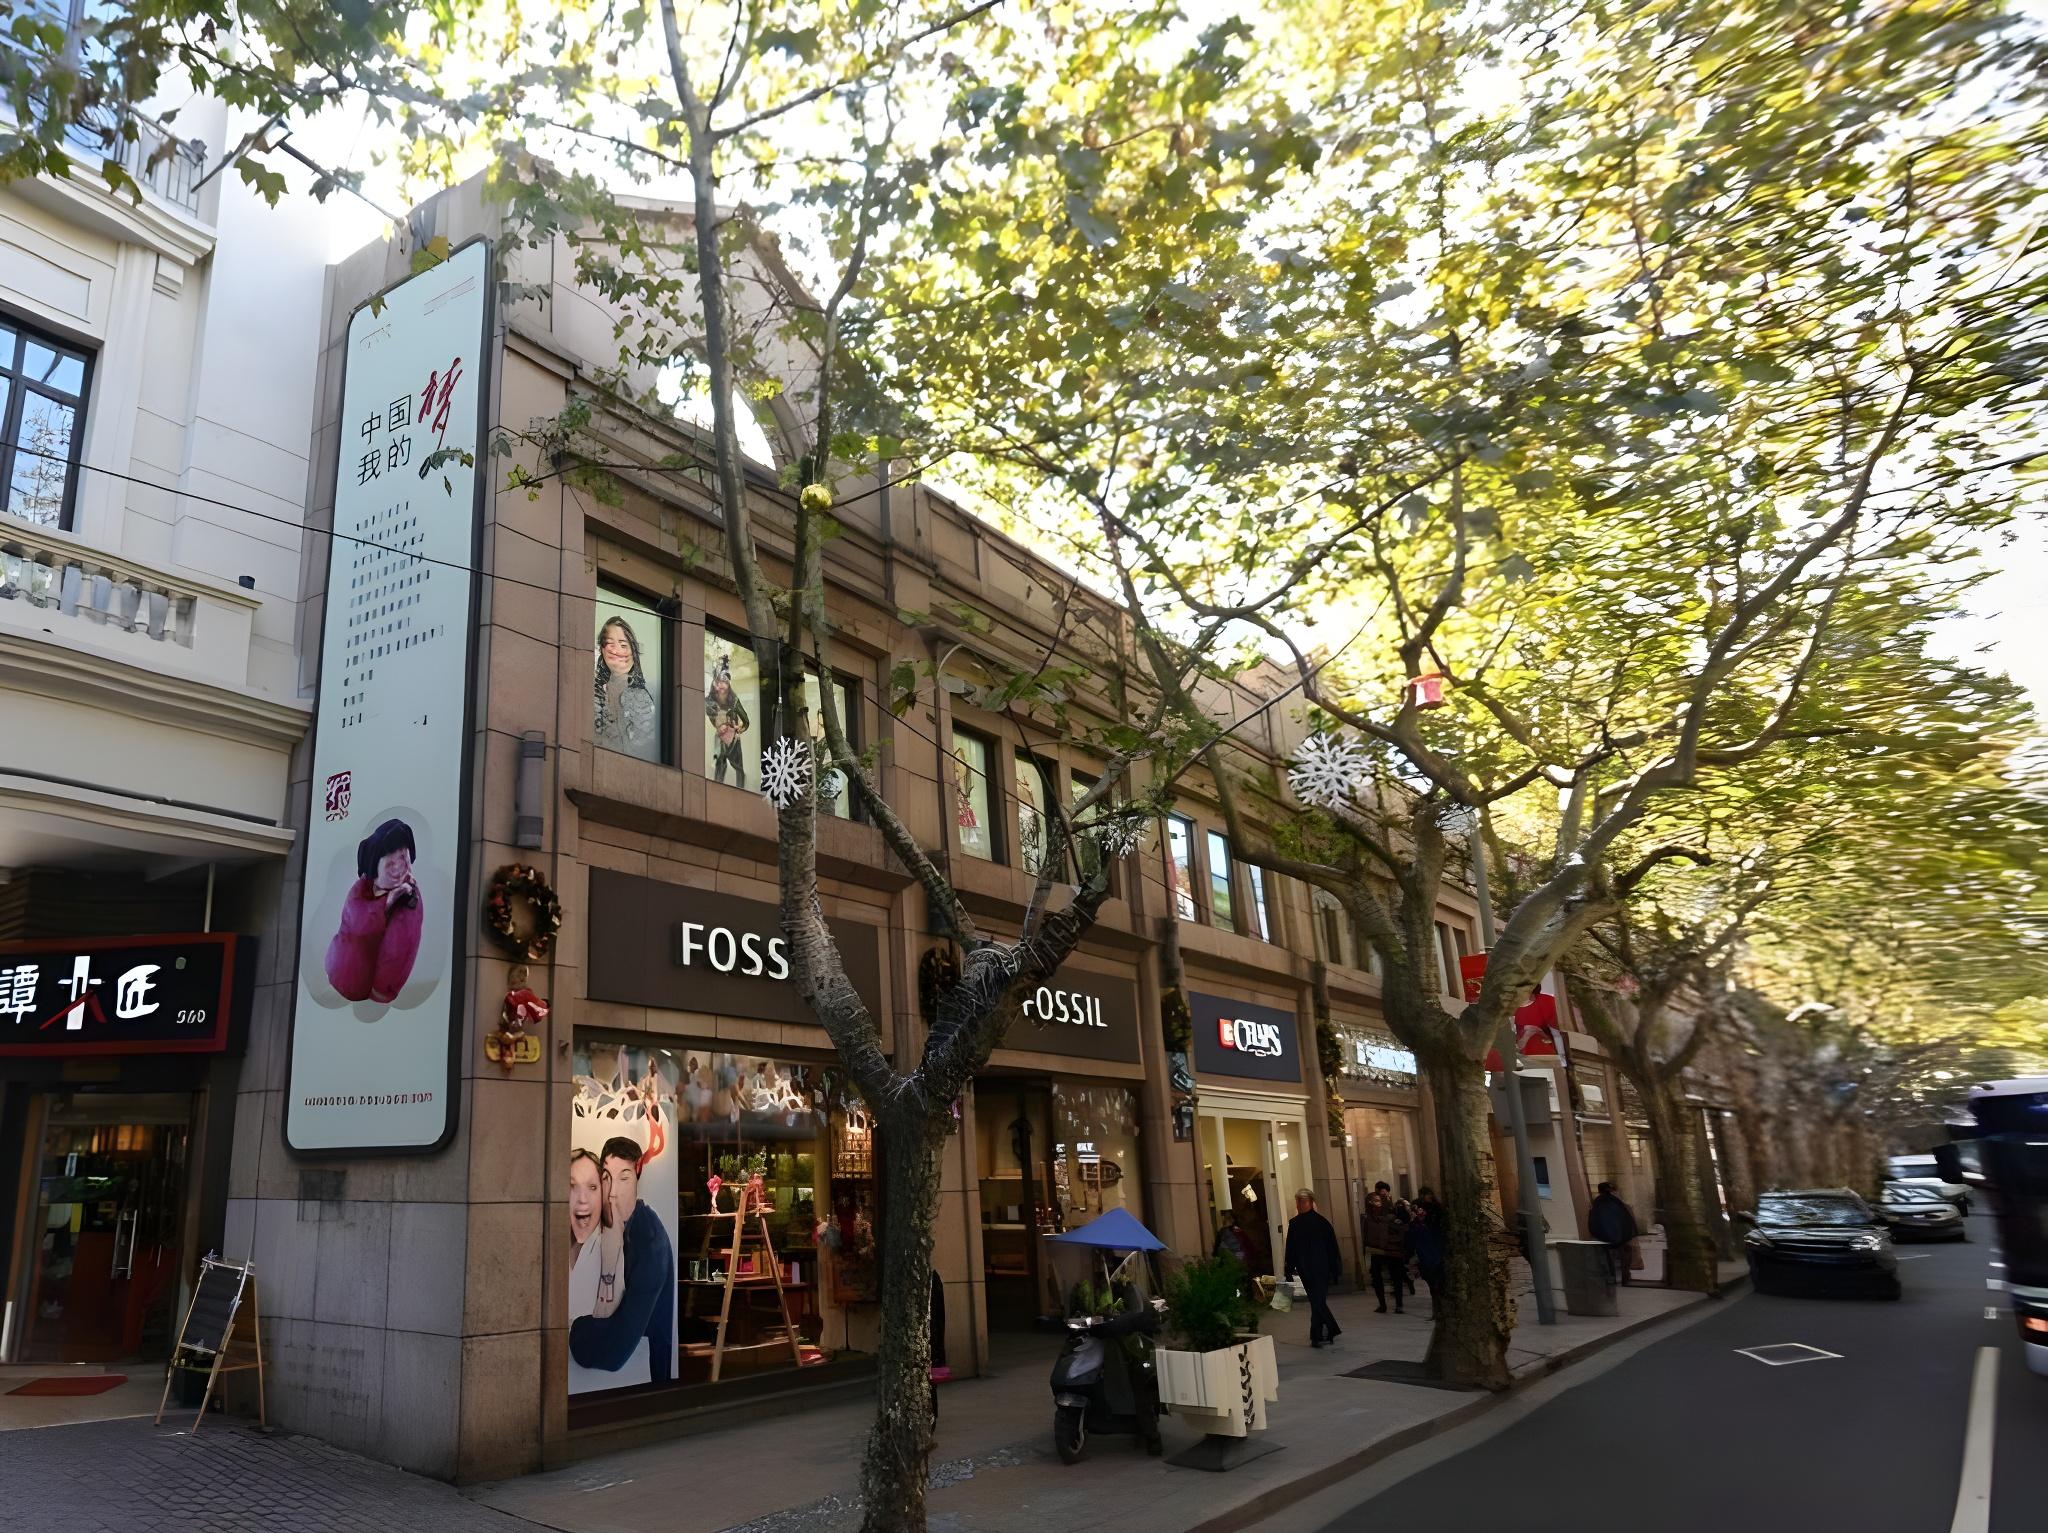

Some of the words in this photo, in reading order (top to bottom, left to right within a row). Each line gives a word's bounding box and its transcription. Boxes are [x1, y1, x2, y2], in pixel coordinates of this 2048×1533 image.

[361, 393, 412, 445] 中国
[357, 433, 412, 487] 我的
[682, 921, 790, 980] FOSS
